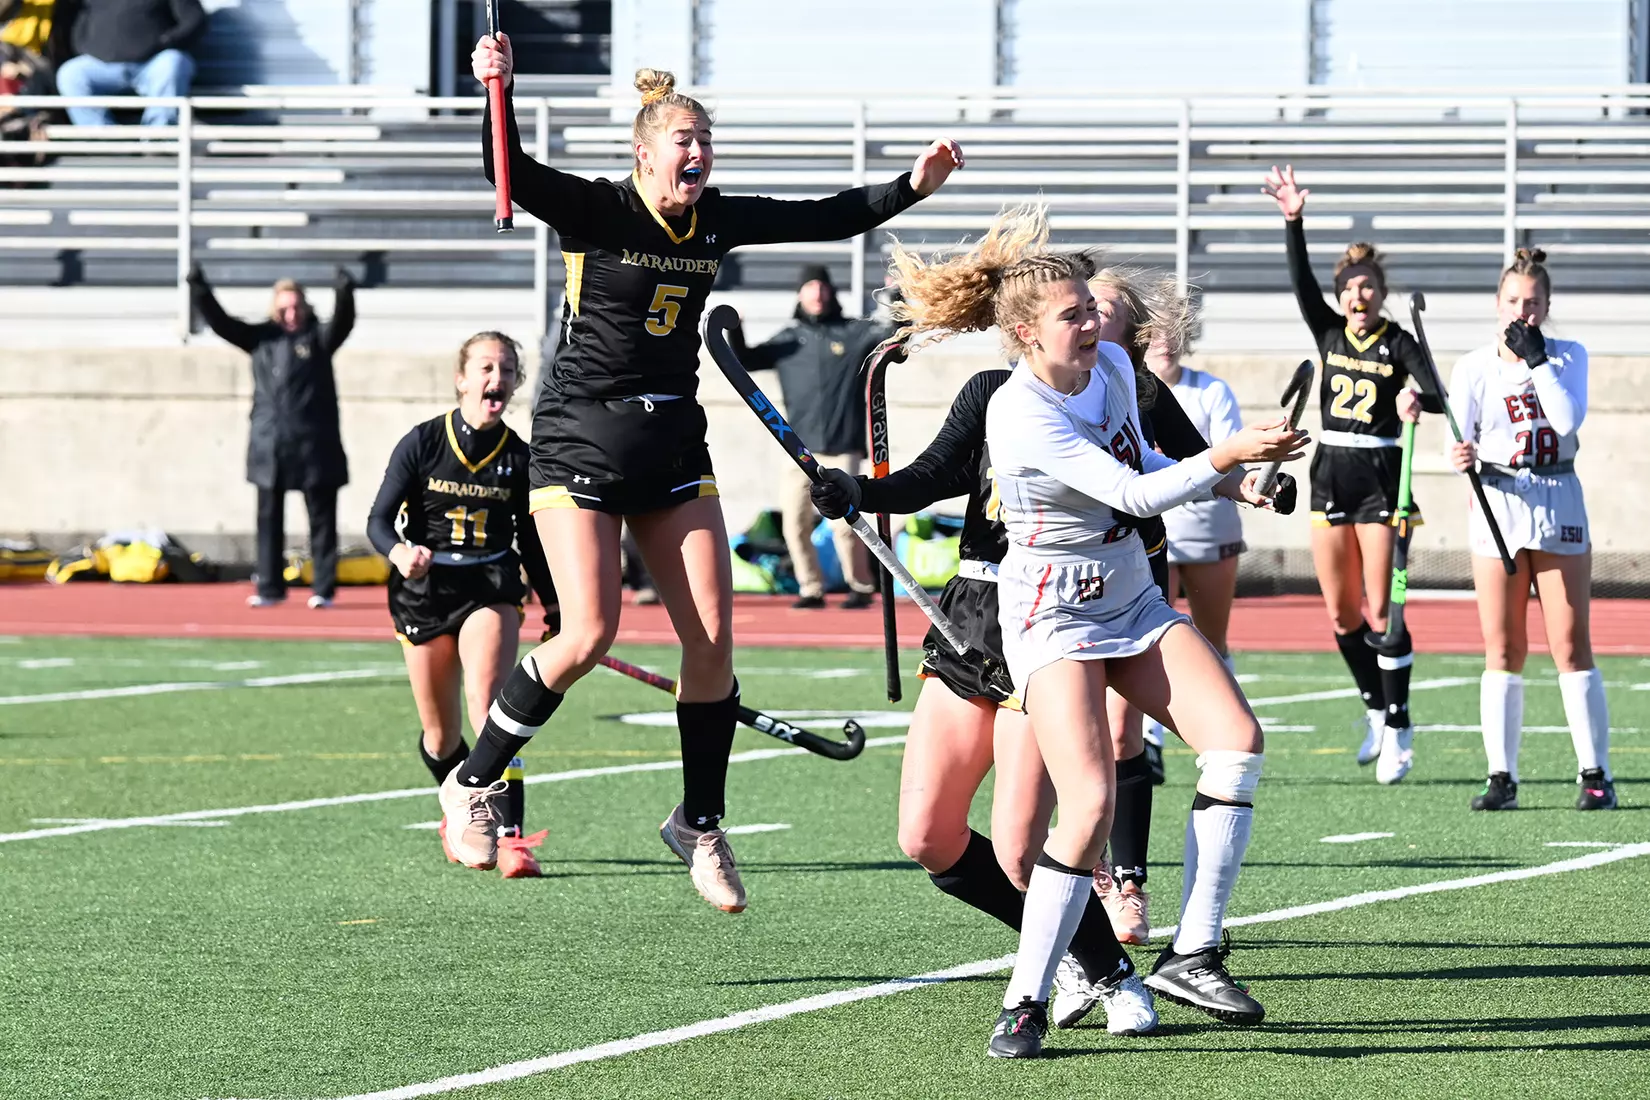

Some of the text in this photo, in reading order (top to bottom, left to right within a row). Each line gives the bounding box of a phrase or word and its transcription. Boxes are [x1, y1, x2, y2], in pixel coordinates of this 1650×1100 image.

[620, 248, 719, 275] MARAUDERS
[644, 283, 689, 336] 5
[748, 390, 793, 441] STX
[1330, 373, 1377, 424] 22
[427, 477, 511, 501] MARAUDERS
[444, 505, 489, 547] 11
[1560, 524, 1583, 544] ESU
[1077, 575, 1104, 603] 23
